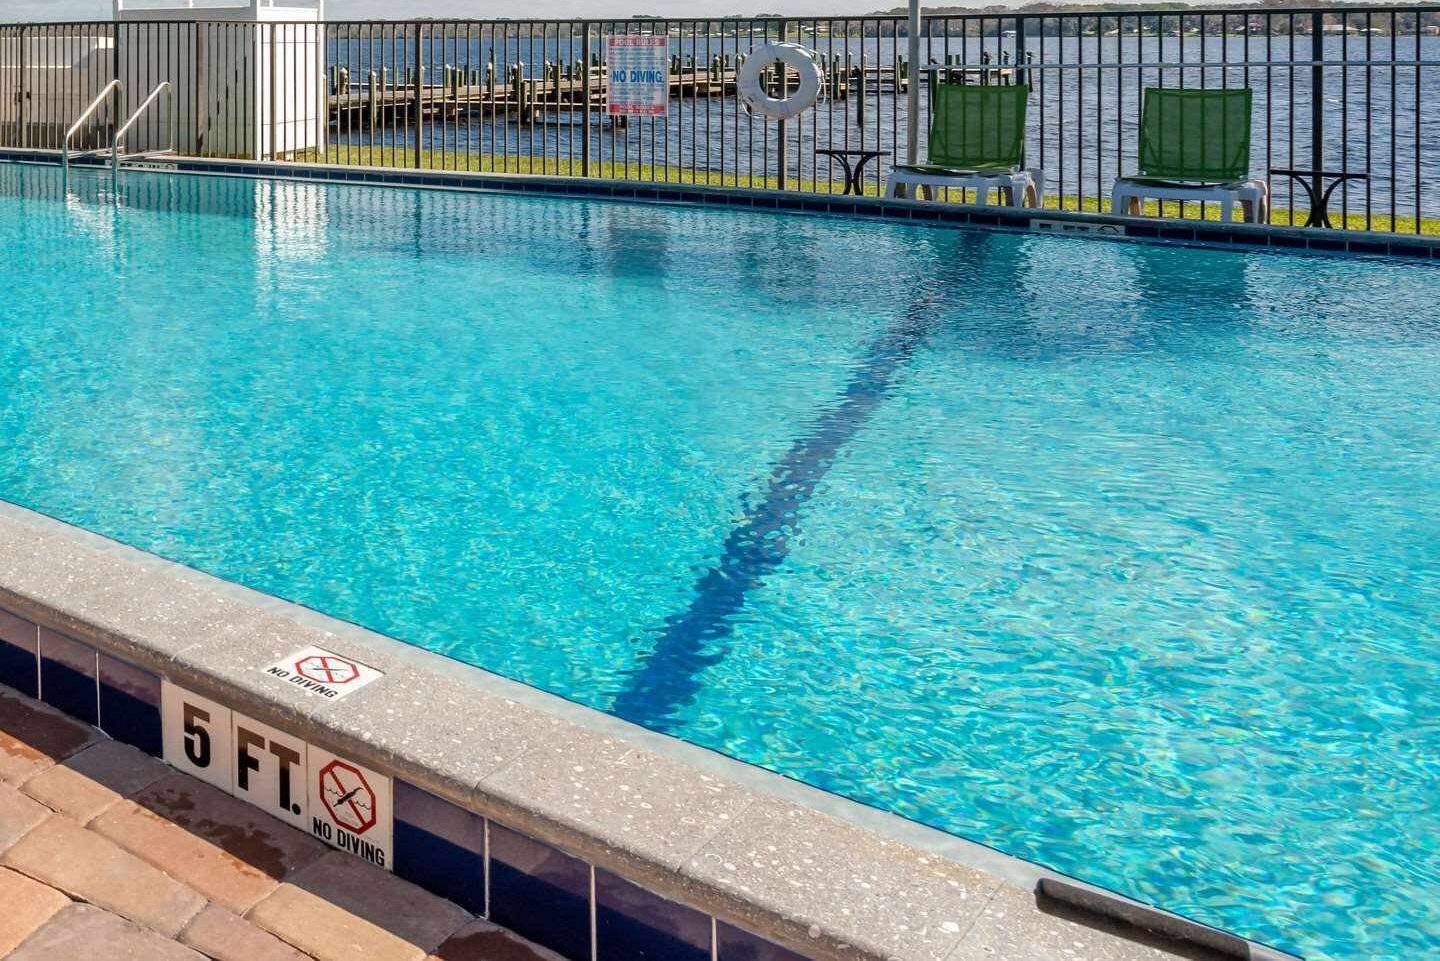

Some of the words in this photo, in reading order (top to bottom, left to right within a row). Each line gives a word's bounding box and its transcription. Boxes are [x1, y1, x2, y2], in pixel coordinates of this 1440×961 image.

[613, 70, 627, 83] NO
[267, 666, 290, 678] NO
[289, 675, 338, 698] DIVING
[183, 701, 210, 768] 5
[237, 725, 301, 816] FT.
[313, 817, 332, 841] NO
[337, 828, 385, 867] DIVING
